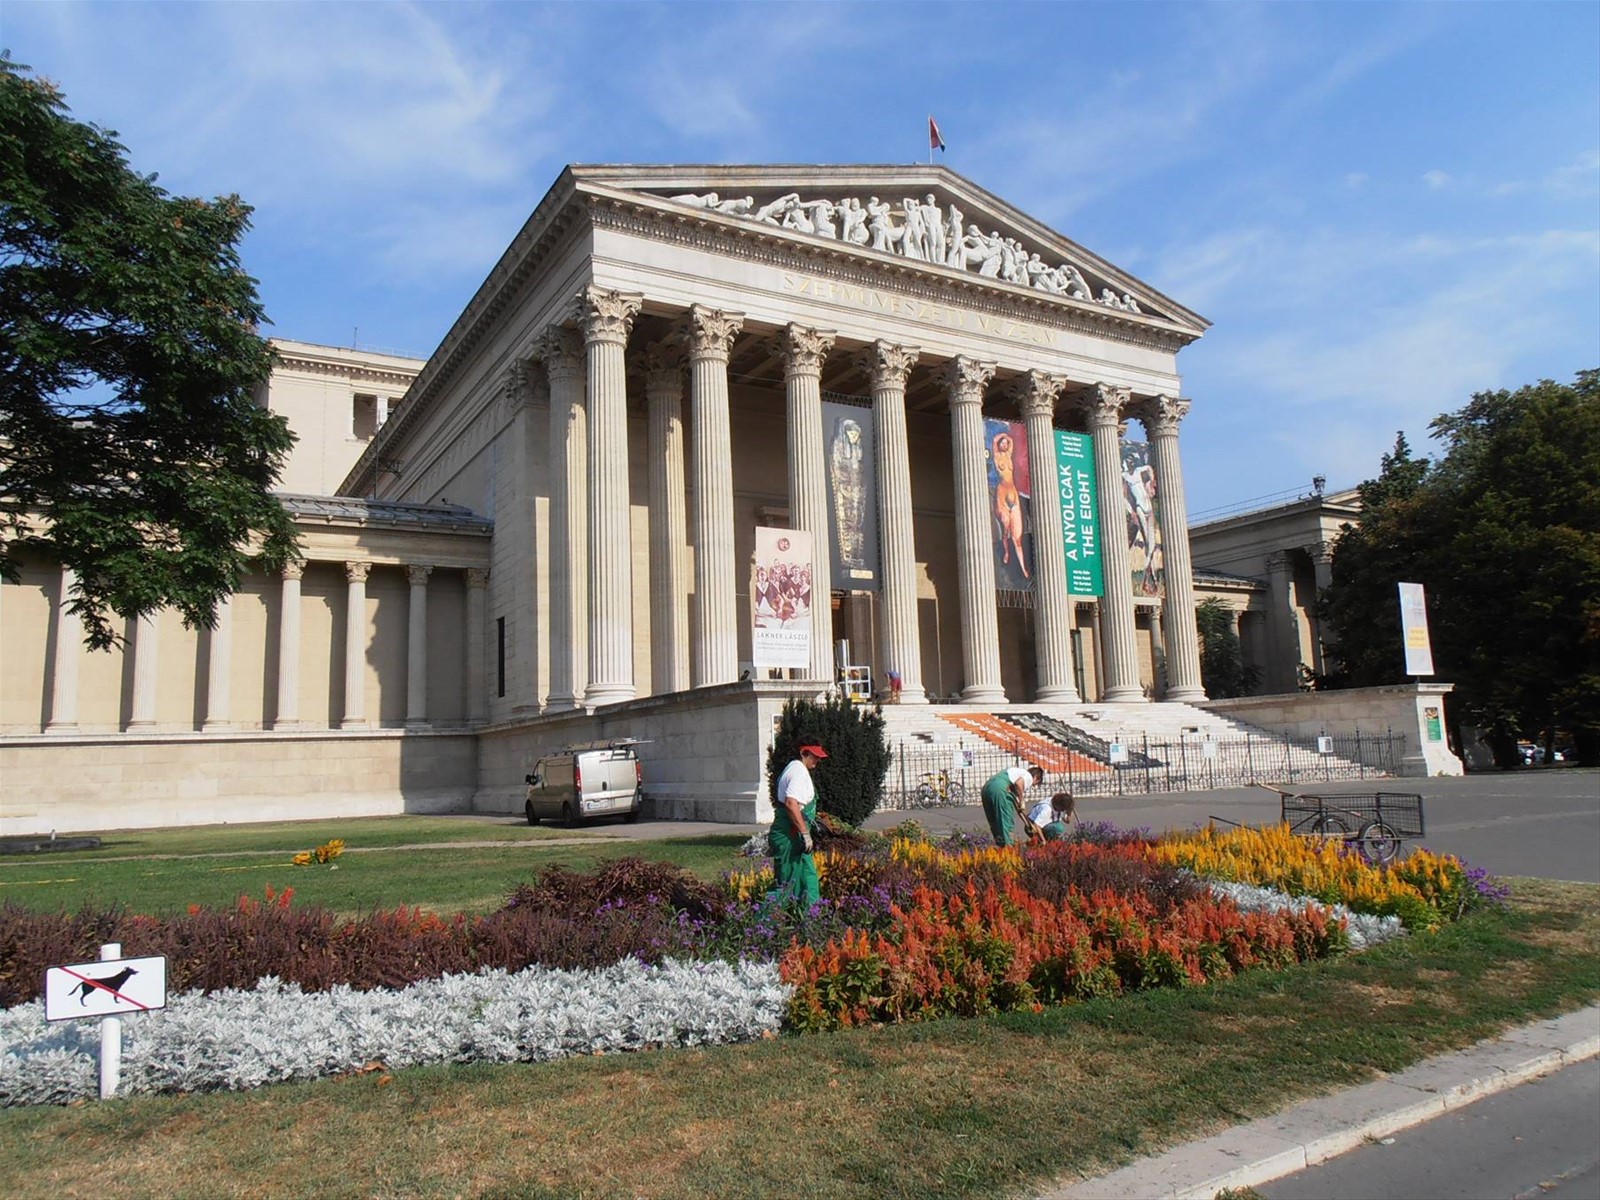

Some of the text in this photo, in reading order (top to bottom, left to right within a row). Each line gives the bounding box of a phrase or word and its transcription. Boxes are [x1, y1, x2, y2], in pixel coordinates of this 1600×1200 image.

[1060, 465, 1077, 544] NYOLCAK
[1077, 470, 1092, 520] EIGHT
[1066, 549, 1078, 561] A
[1081, 525, 1094, 558] THE
